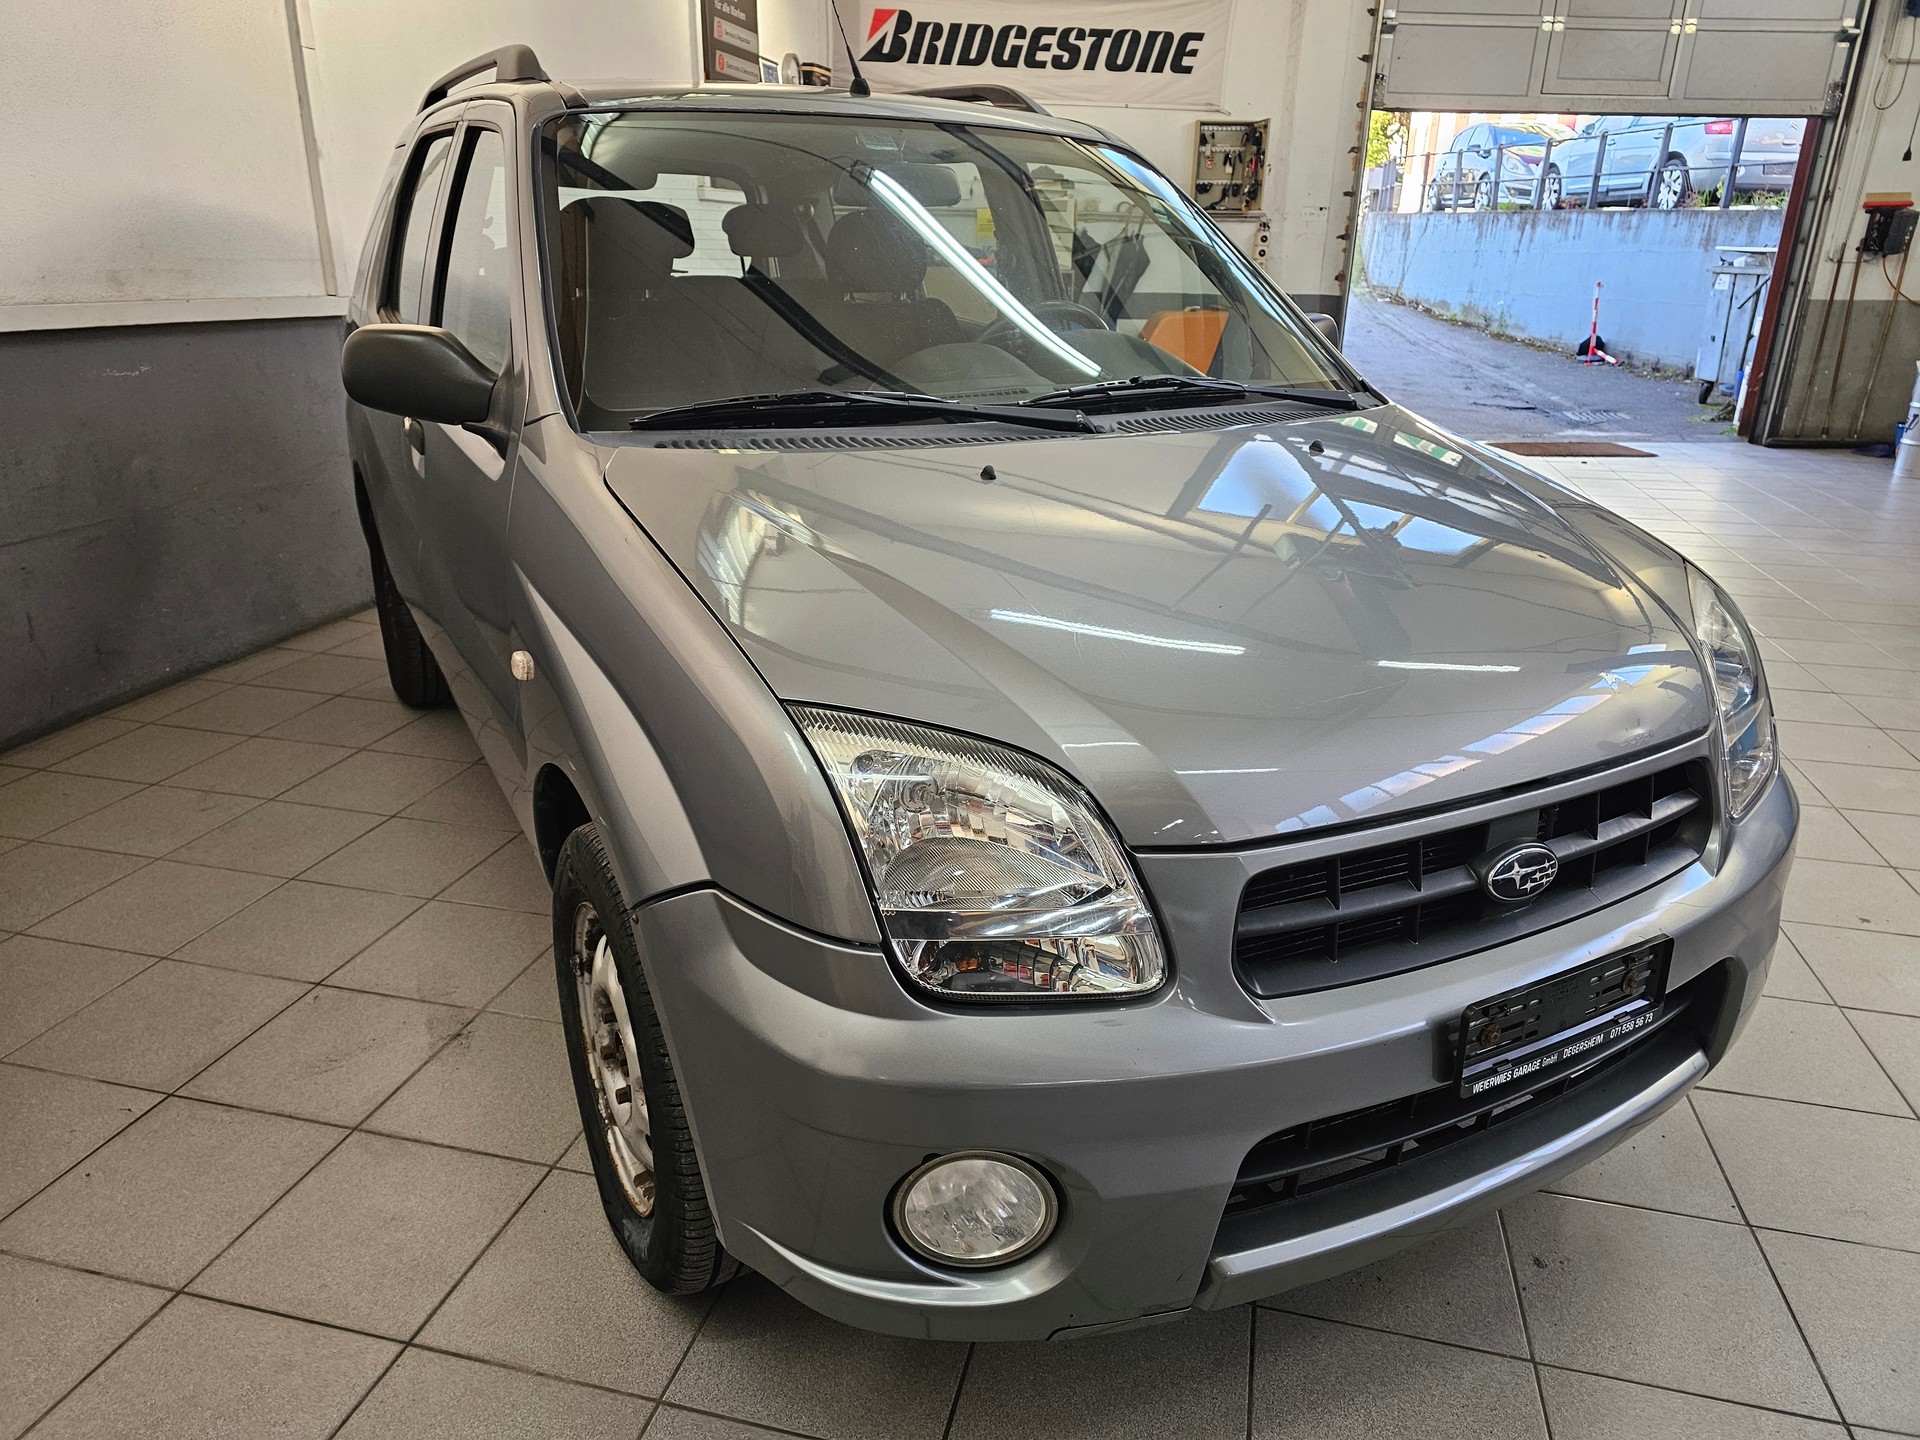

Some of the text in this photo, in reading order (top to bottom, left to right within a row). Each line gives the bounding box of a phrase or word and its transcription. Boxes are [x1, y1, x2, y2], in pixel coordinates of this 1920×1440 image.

[859, 9, 1205, 74] BRIDGESTONE
[1472, 1012, 1654, 1094] WEIERWIES GARAGE GmbH DEGERSHEIM 071 558 56 73
